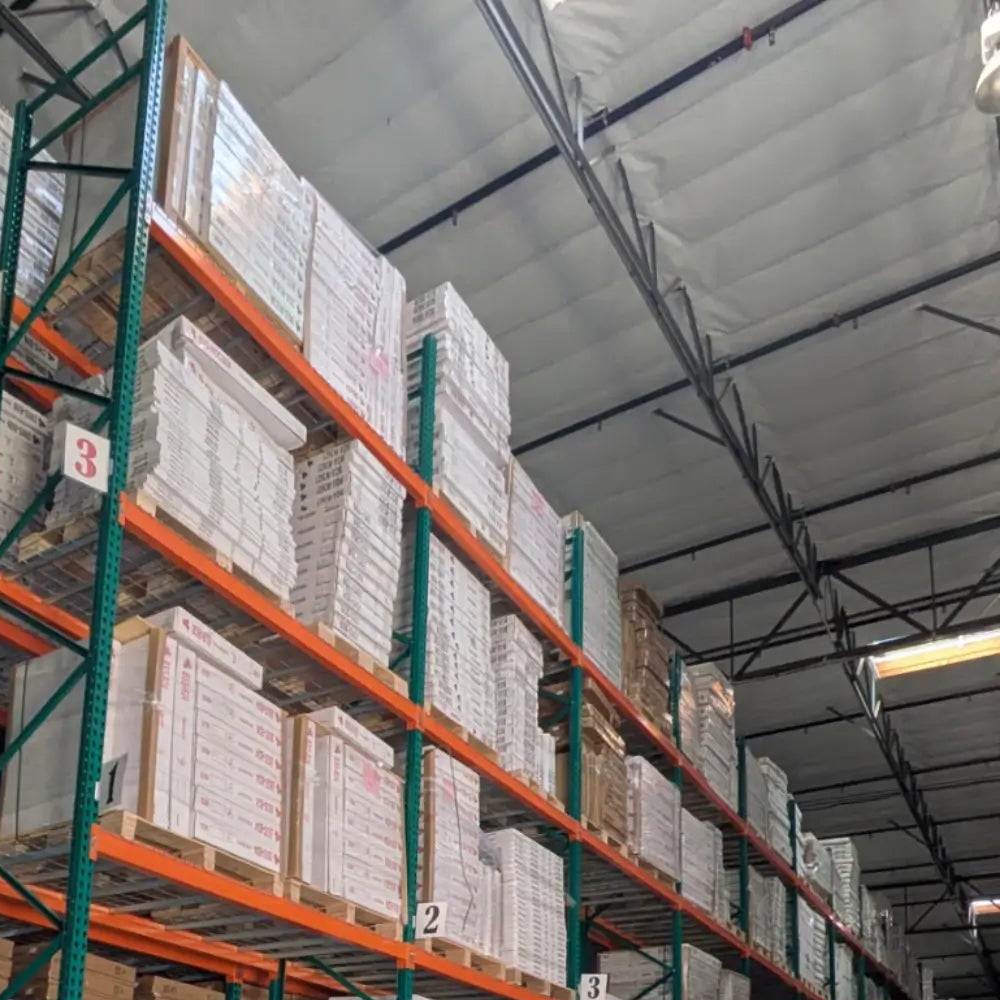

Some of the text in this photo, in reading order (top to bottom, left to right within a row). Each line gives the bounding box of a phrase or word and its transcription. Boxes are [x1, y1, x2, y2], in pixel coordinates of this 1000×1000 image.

[75, 438, 97, 478] 3
[106, 761, 118, 804] 1
[423, 905, 440, 935] 2
[588, 976, 600, 999] 3
